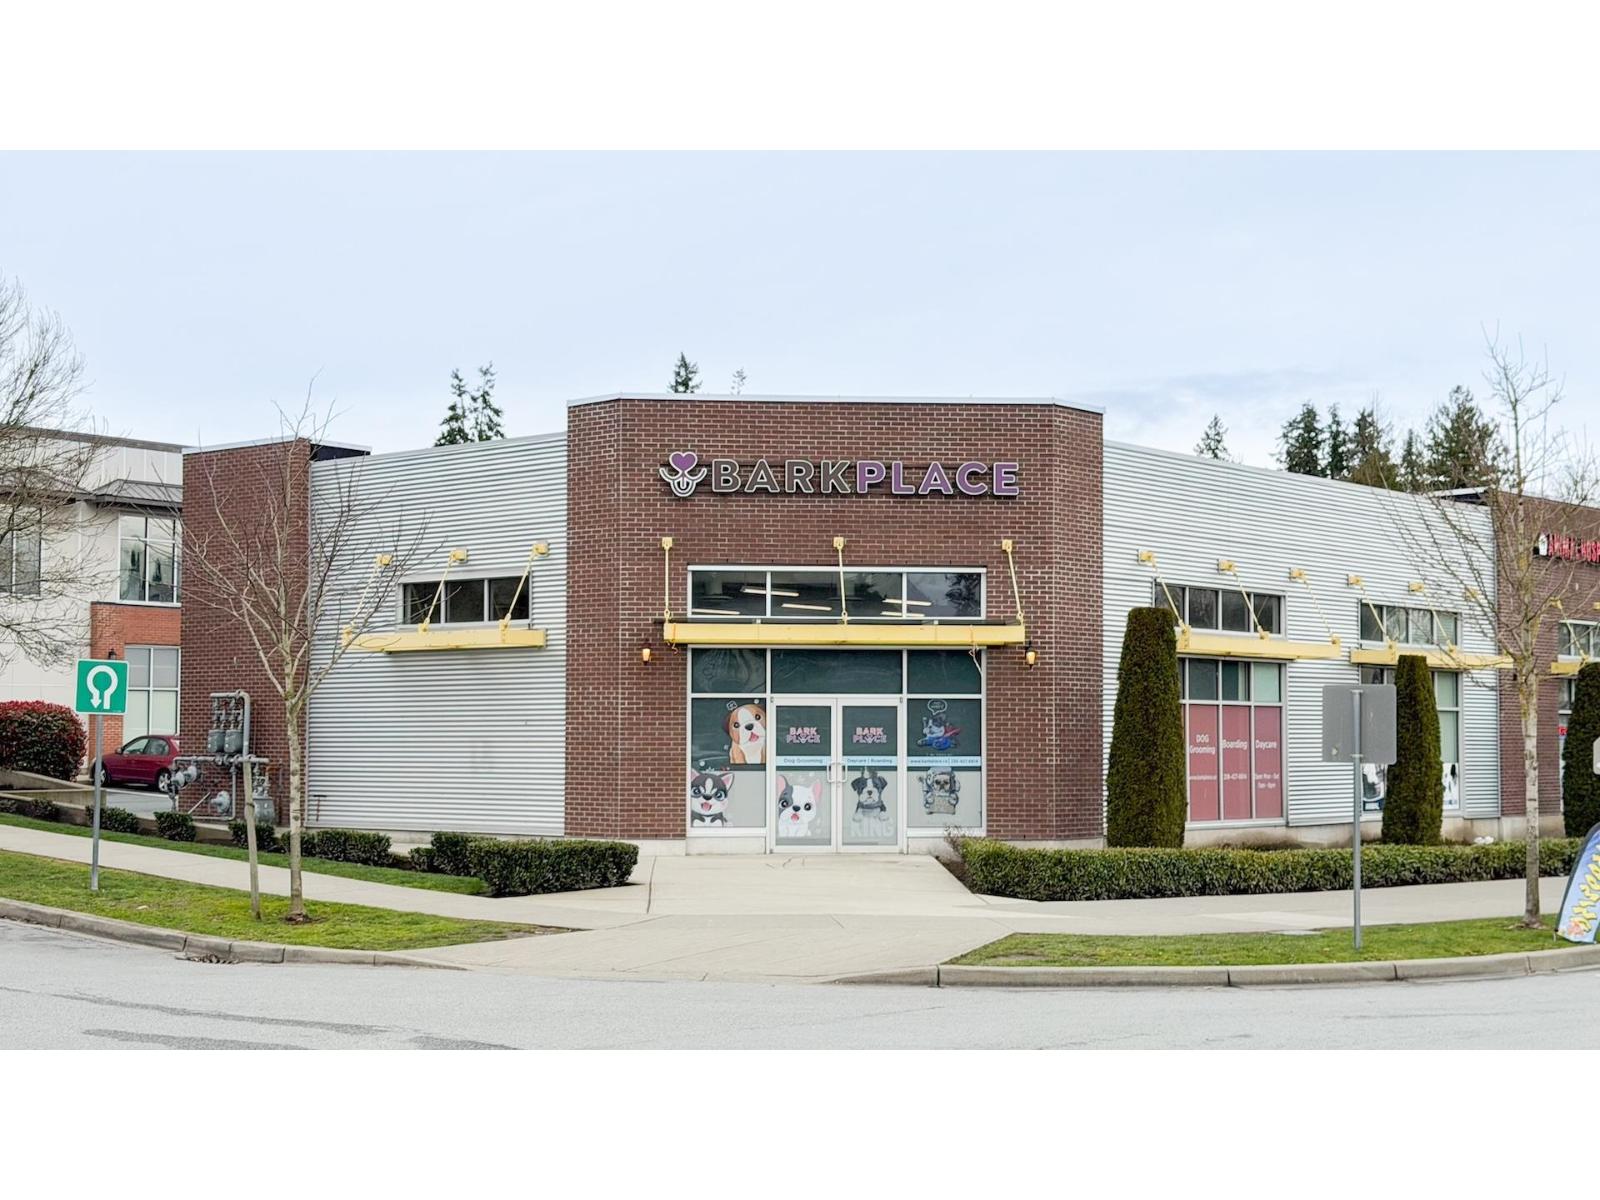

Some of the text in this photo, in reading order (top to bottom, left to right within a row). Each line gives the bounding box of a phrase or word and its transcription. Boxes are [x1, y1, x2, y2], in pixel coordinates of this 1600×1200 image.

[789, 727, 818, 735] BARK
[855, 727, 884, 735] BARK
[1196, 734, 1209, 743] DOG
[1222, 739, 1248, 750] Boarding
[1255, 739, 1277, 750] Daycare
[1189, 745, 1216, 755] Grooming
